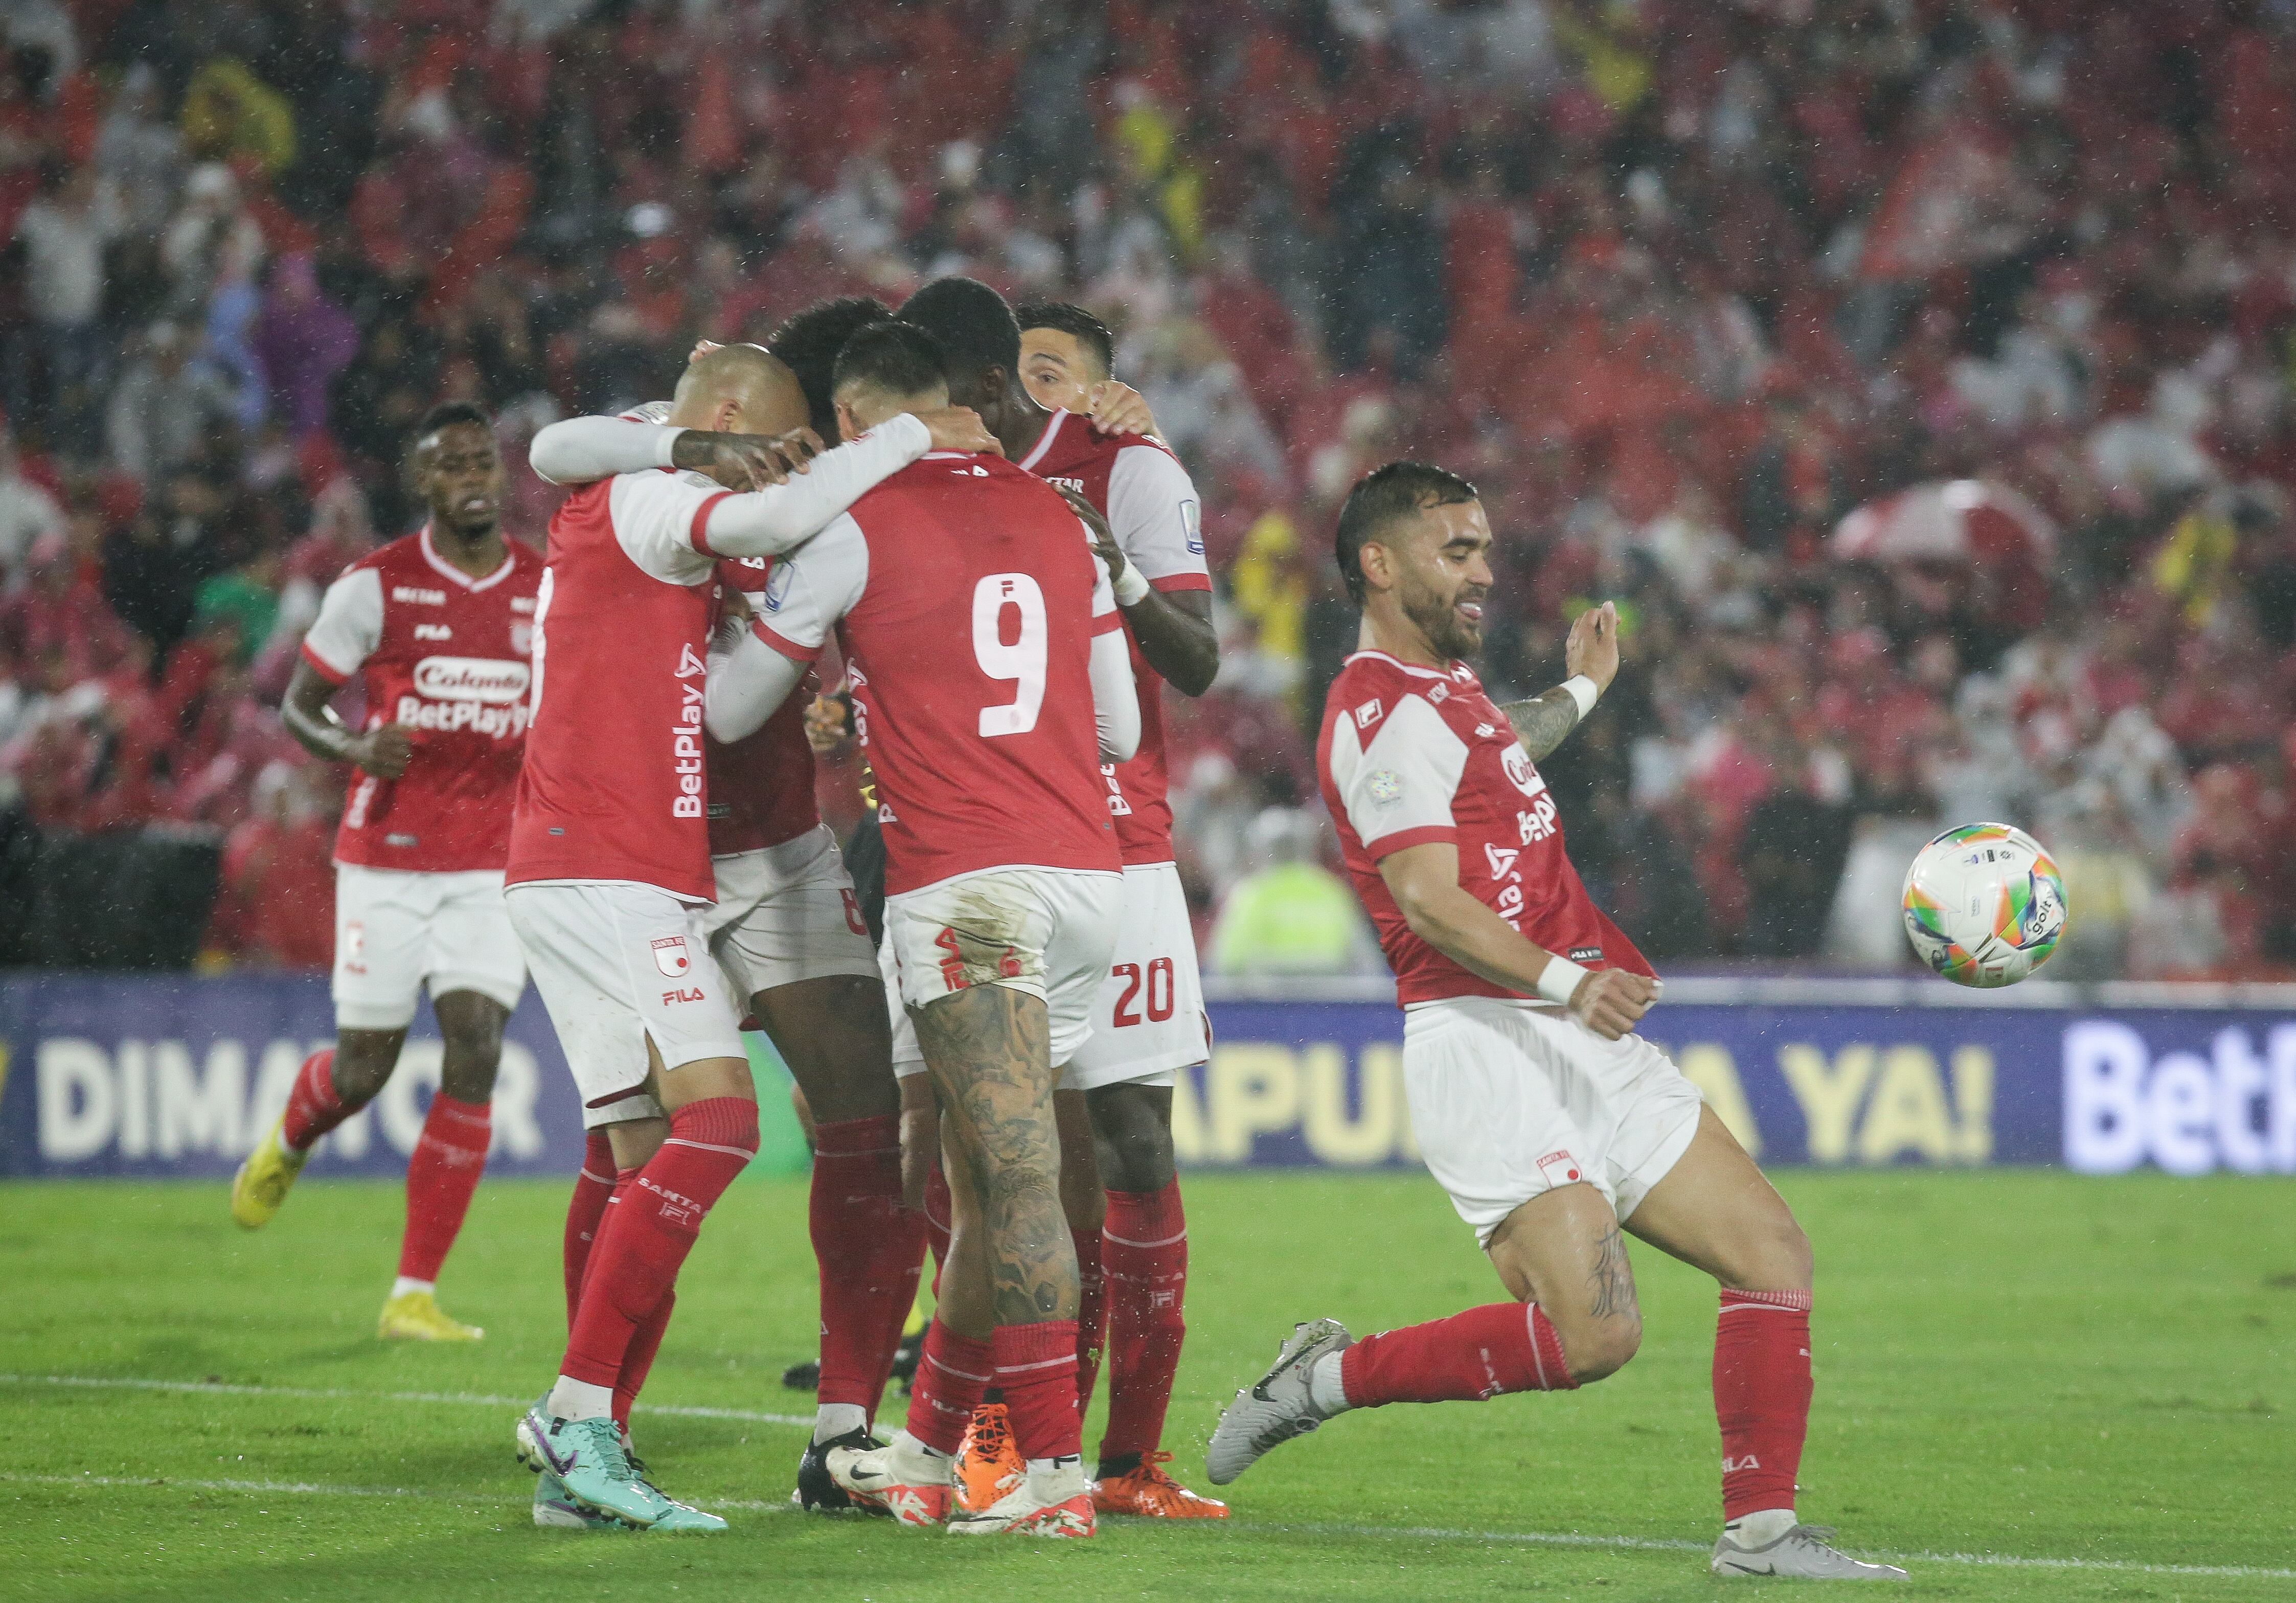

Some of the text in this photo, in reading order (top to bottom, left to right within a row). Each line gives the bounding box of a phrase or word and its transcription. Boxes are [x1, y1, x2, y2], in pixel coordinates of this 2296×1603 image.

[972, 572, 1047, 738] 9
[672, 683, 705, 818] BetPlay
[662, 987, 704, 1006] FILA
[1112, 957, 1173, 1028] 20
[1777, 1043, 1994, 1164] YA!
[638, 1177, 702, 1214] SANTA
